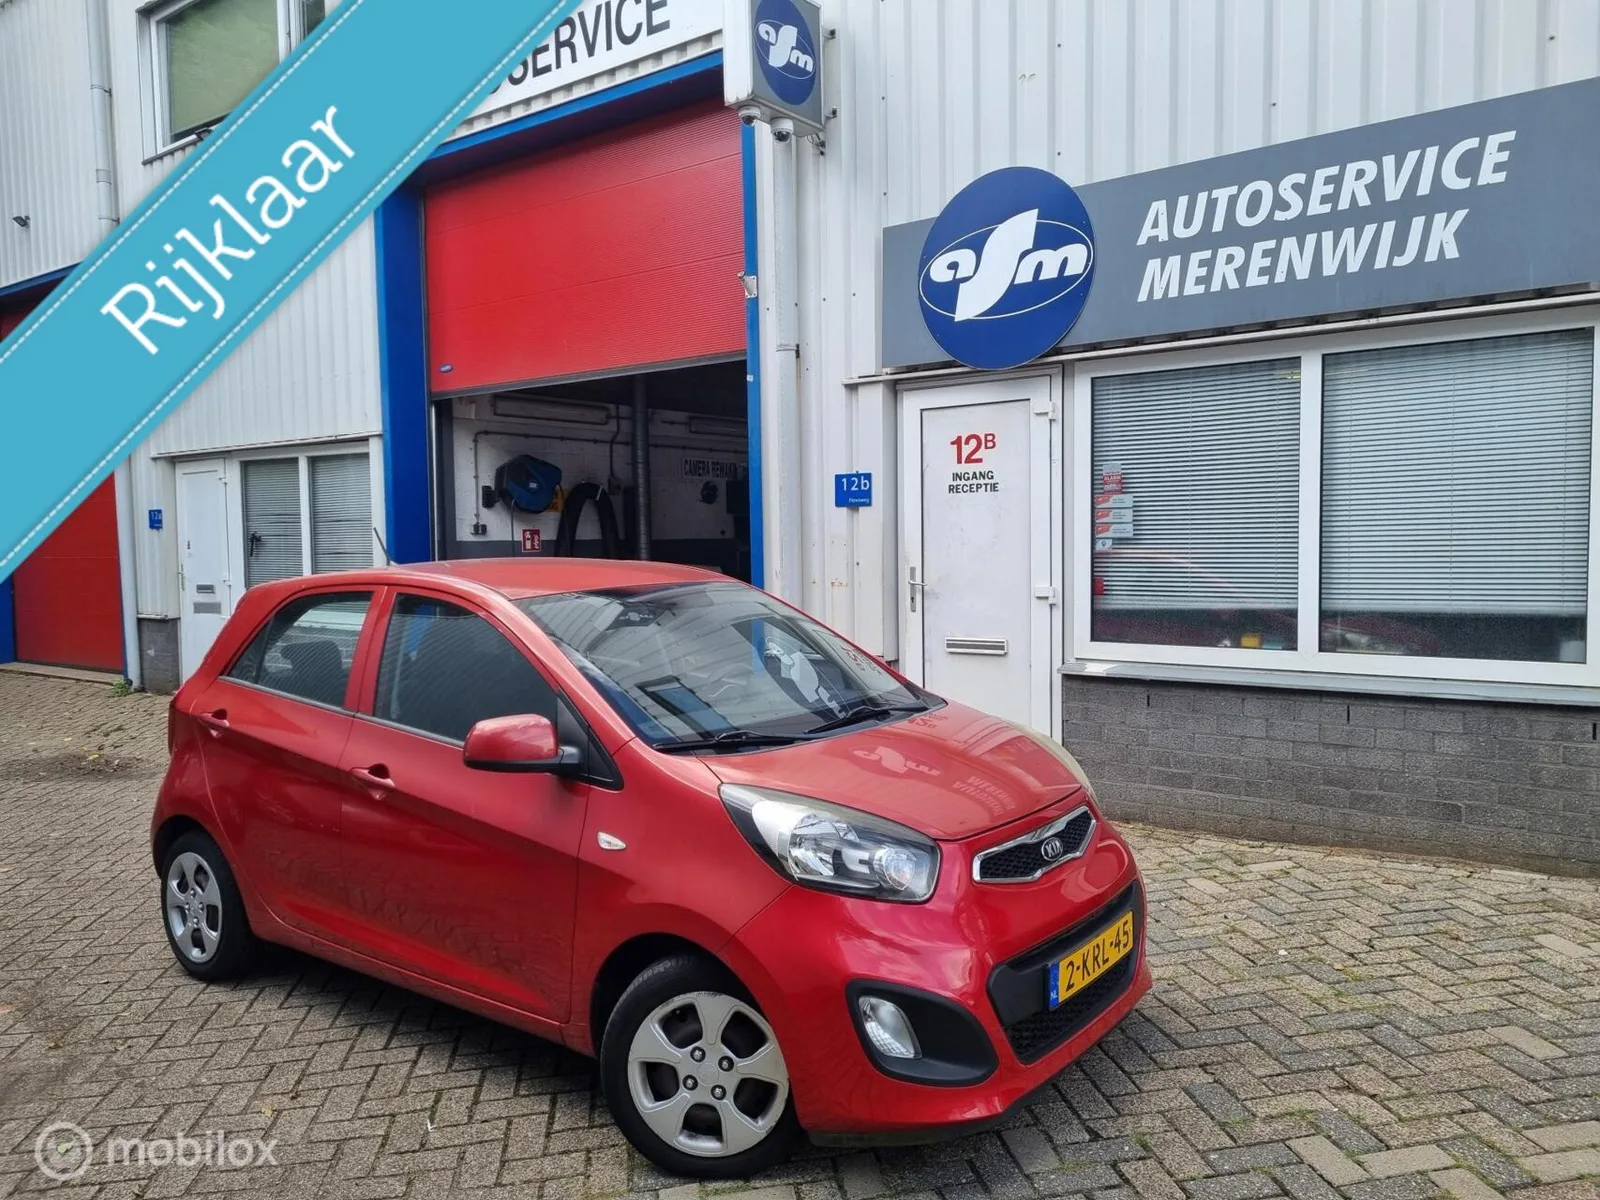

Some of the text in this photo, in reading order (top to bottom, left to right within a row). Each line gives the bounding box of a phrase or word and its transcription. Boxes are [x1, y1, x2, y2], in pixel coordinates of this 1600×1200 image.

[1137, 130, 1517, 247] AUTOSERVICE
[1137, 209, 1469, 303] MERENWIJK
[841, 475, 870, 492] 12b
[952, 470, 995, 482] INGANG
[948, 482, 1000, 494] RECEPTIE
[1045, 840, 1063, 858] KIA
[1065, 919, 1130, 992] 2-KRL-45
